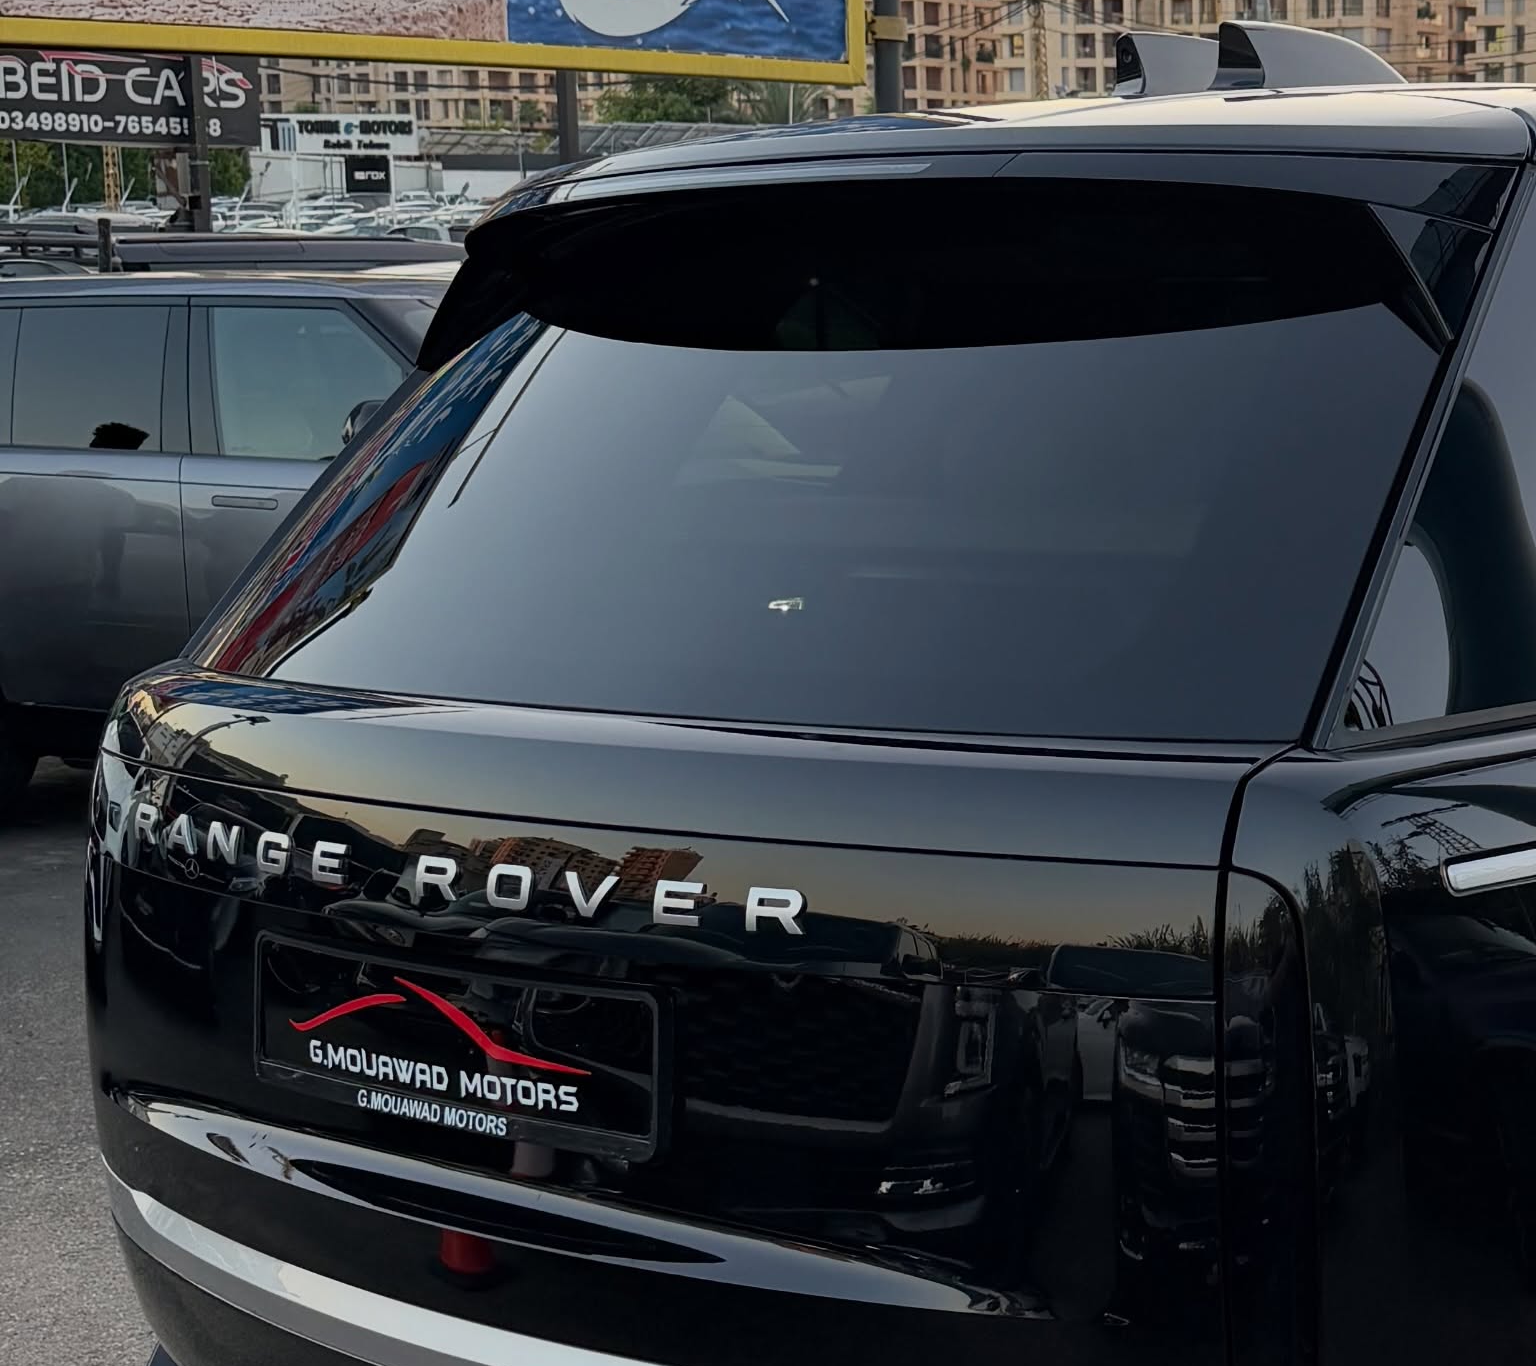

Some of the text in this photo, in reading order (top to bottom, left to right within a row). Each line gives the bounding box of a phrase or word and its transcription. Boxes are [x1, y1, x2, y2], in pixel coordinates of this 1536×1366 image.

[0, 112, 222, 137] 03498910-765458
[133, 802, 805, 936] RANGE ROVER
[309, 1038, 579, 1112] G.MOUAWAD MOTORS
[357, 1088, 507, 1136] G.MOUAWAD MOTORS
